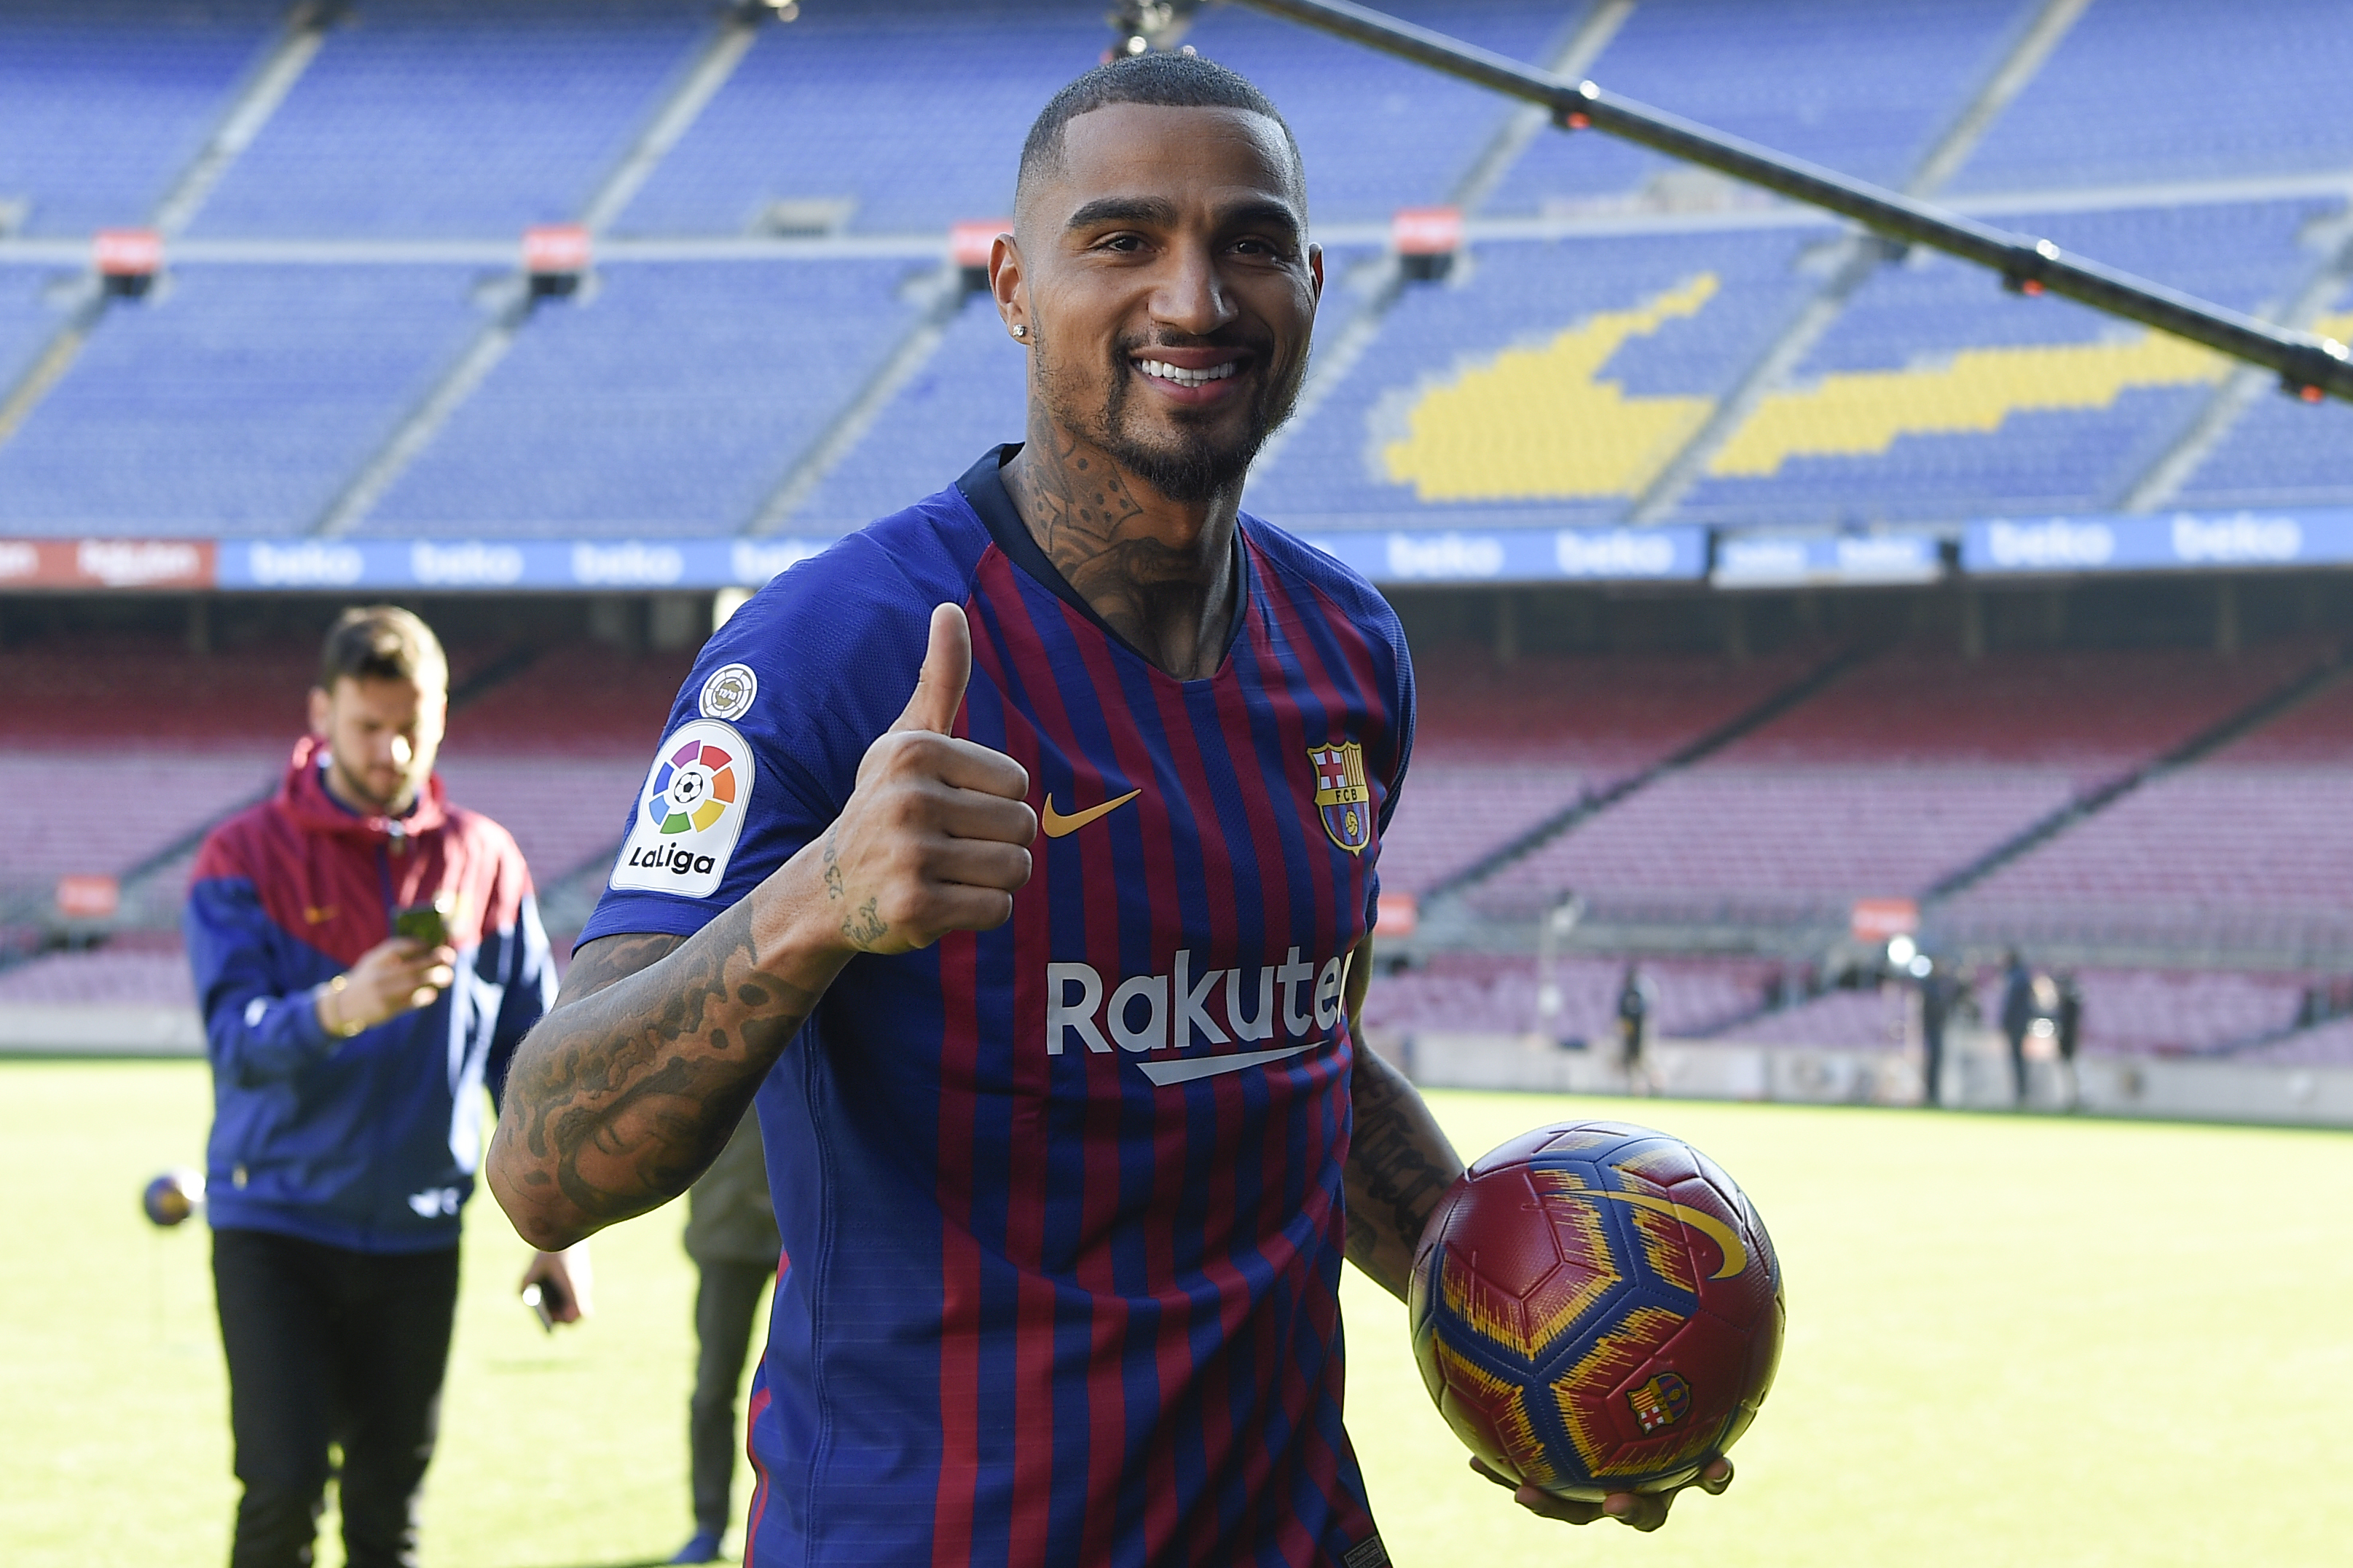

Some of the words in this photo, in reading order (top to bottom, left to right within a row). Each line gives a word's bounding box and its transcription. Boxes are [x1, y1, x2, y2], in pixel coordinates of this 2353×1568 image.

[1335, 788, 1358, 803] FCB
[628, 841, 715, 875] LaLiga
[1046, 946, 1354, 1055] Rakute
